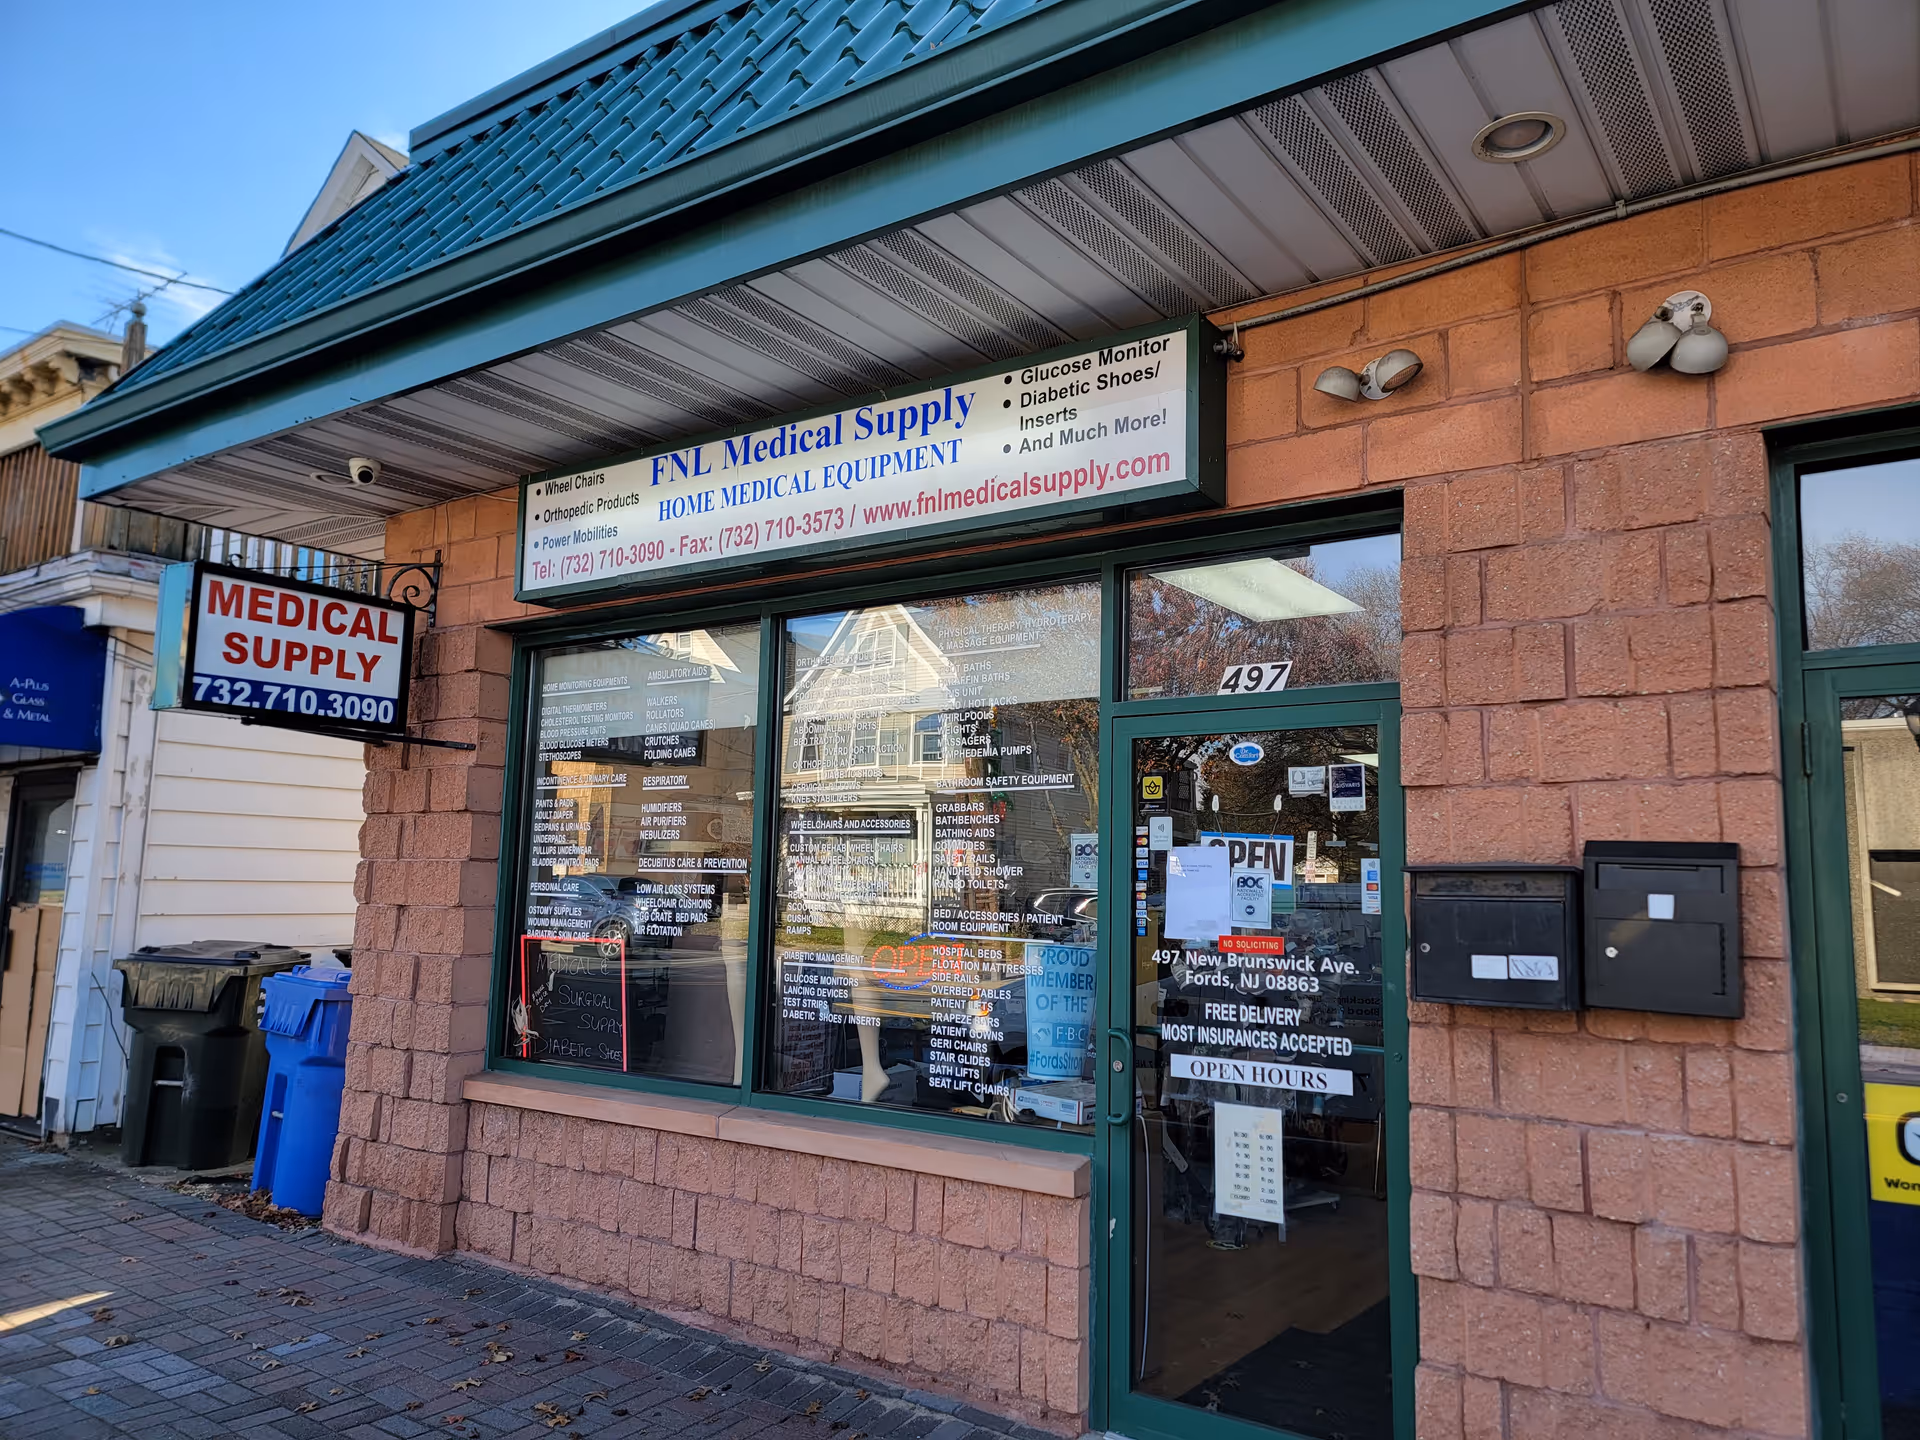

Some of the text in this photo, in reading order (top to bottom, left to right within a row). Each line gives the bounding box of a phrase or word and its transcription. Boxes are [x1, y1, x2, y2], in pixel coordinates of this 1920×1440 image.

[1020, 337, 1170, 386] Glucose Monitor
[1020, 361, 1161, 409] Diabetic Shoes/
[1020, 406, 1078, 432] Inserts
[649, 387, 976, 487] FNL Medical Supply
[1018, 409, 1167, 455] And Much More!
[545, 471, 605, 500] Wheel Chairs
[658, 438, 962, 522] HOME MEDICAL EQUIPMENT
[543, 491, 639, 524] Orthopedic Products
[532, 560, 556, 582] Tel:
[560, 550, 594, 580] (732)
[599, 540, 664, 571] 710-3090
[679, 534, 713, 560] Fax:
[718, 526, 759, 557] (732)
[765, 506, 844, 542] 710-3573
[863, 451, 1171, 526] www.fnlmedicalsupply.com
[542, 524, 618, 553] Power Mobilities
[207, 579, 399, 645] MEDICAL
[938, 627, 980, 639] PHYSICAL
[221, 632, 382, 683] SUPPLY
[647, 665, 708, 681] AMBULATORY AIDS
[1221, 663, 1289, 693] 497
[193, 676, 395, 724] 732.710.3090
[647, 695, 678, 707] WALKERS
[3, 708, 51, 723] & METAL
[646, 707, 684, 720] ROLLATORS
[937, 710, 995, 724] WHIRLPOOLS
[644, 735, 679, 747] CRUTCHES
[937, 734, 992, 748] MASSAGERS
[538, 751, 581, 762] STETHOSCOPES
[644, 747, 696, 760] FOLDING CANES
[1000, 744, 1032, 756] PUMPS
[643, 775, 687, 786] RESPIRATORY
[936, 773, 1074, 789] BATHROOM SAFETY EQUIPMENT
[641, 802, 682, 813] HUMIDIFIERS
[935, 803, 984, 813] GRABBARS
[640, 816, 686, 826] AIR PURIFIERS
[791, 819, 911, 829] WHEELCHAIRS AND ACCESSORIES
[935, 814, 1000, 825] BATHBENCHES
[640, 830, 680, 840] NEBULIZERS
[935, 828, 995, 838] BATHING AIDS
[638, 858, 747, 869] DECUBITUS CARE & PREVENTION
[934, 866, 1023, 877] HANDHELD SHOWER
[530, 882, 579, 892] PERSONAL CARE
[1237, 876, 1265, 889] BOC
[635, 898, 712, 909] WHEELCHAIR CUSHIONS
[528, 906, 582, 917] OSTOMY SUPPLIES
[933, 909, 1064, 925] BED ACCESSORIES PATIENT
[932, 921, 1010, 933] ROOM EQUIPMENT
[932, 946, 1002, 960] HOSPITAL BEDS
[1223, 940, 1280, 951] NO SOLICITING
[537, 951, 596, 976] MEDICAL
[784, 951, 865, 965] DIABETIC MANAGEMENT
[872, 945, 965, 979] OPEN
[1152, 949, 1361, 976] 497 New Brunswick Ave.
[932, 959, 1043, 977] FLOTATION MATTRESSES
[784, 973, 859, 988] GLUCOSE MONITORS
[932, 972, 980, 984] SIDE RAILS
[1031, 971, 1094, 991] MEMBER
[1186, 970, 1320, 993] Fords, NJ 08863
[558, 984, 618, 1012] SURGICAL
[783, 985, 849, 999] LANCING DEVICES
[931, 985, 1012, 1000] OVERBED TABLES
[783, 997, 828, 1010] TEST STRIPS
[930, 998, 966, 1010] PATIENT
[1036, 994, 1088, 1014] OF THE
[819, 1012, 881, 1028] SHOES INSERTS
[931, 1012, 972, 1025] TRAPEZE
[1205, 1002, 1302, 1027] FREE DELIVERY
[577, 1013, 622, 1038] SUPPLY
[931, 1025, 1004, 1042] PATIENT GOWNS
[1161, 1023, 1352, 1057] MOST INSURANCES ACCEPTED
[930, 1037, 988, 1054] GERI CHAIRS
[929, 1051, 991, 1068] STAIR GLIDES
[929, 1064, 979, 1080] BATH LIFTS
[1190, 1060, 1328, 1091] OPEN HOURS
[928, 1077, 1010, 1097] SEAT LIFT CHAIRS
